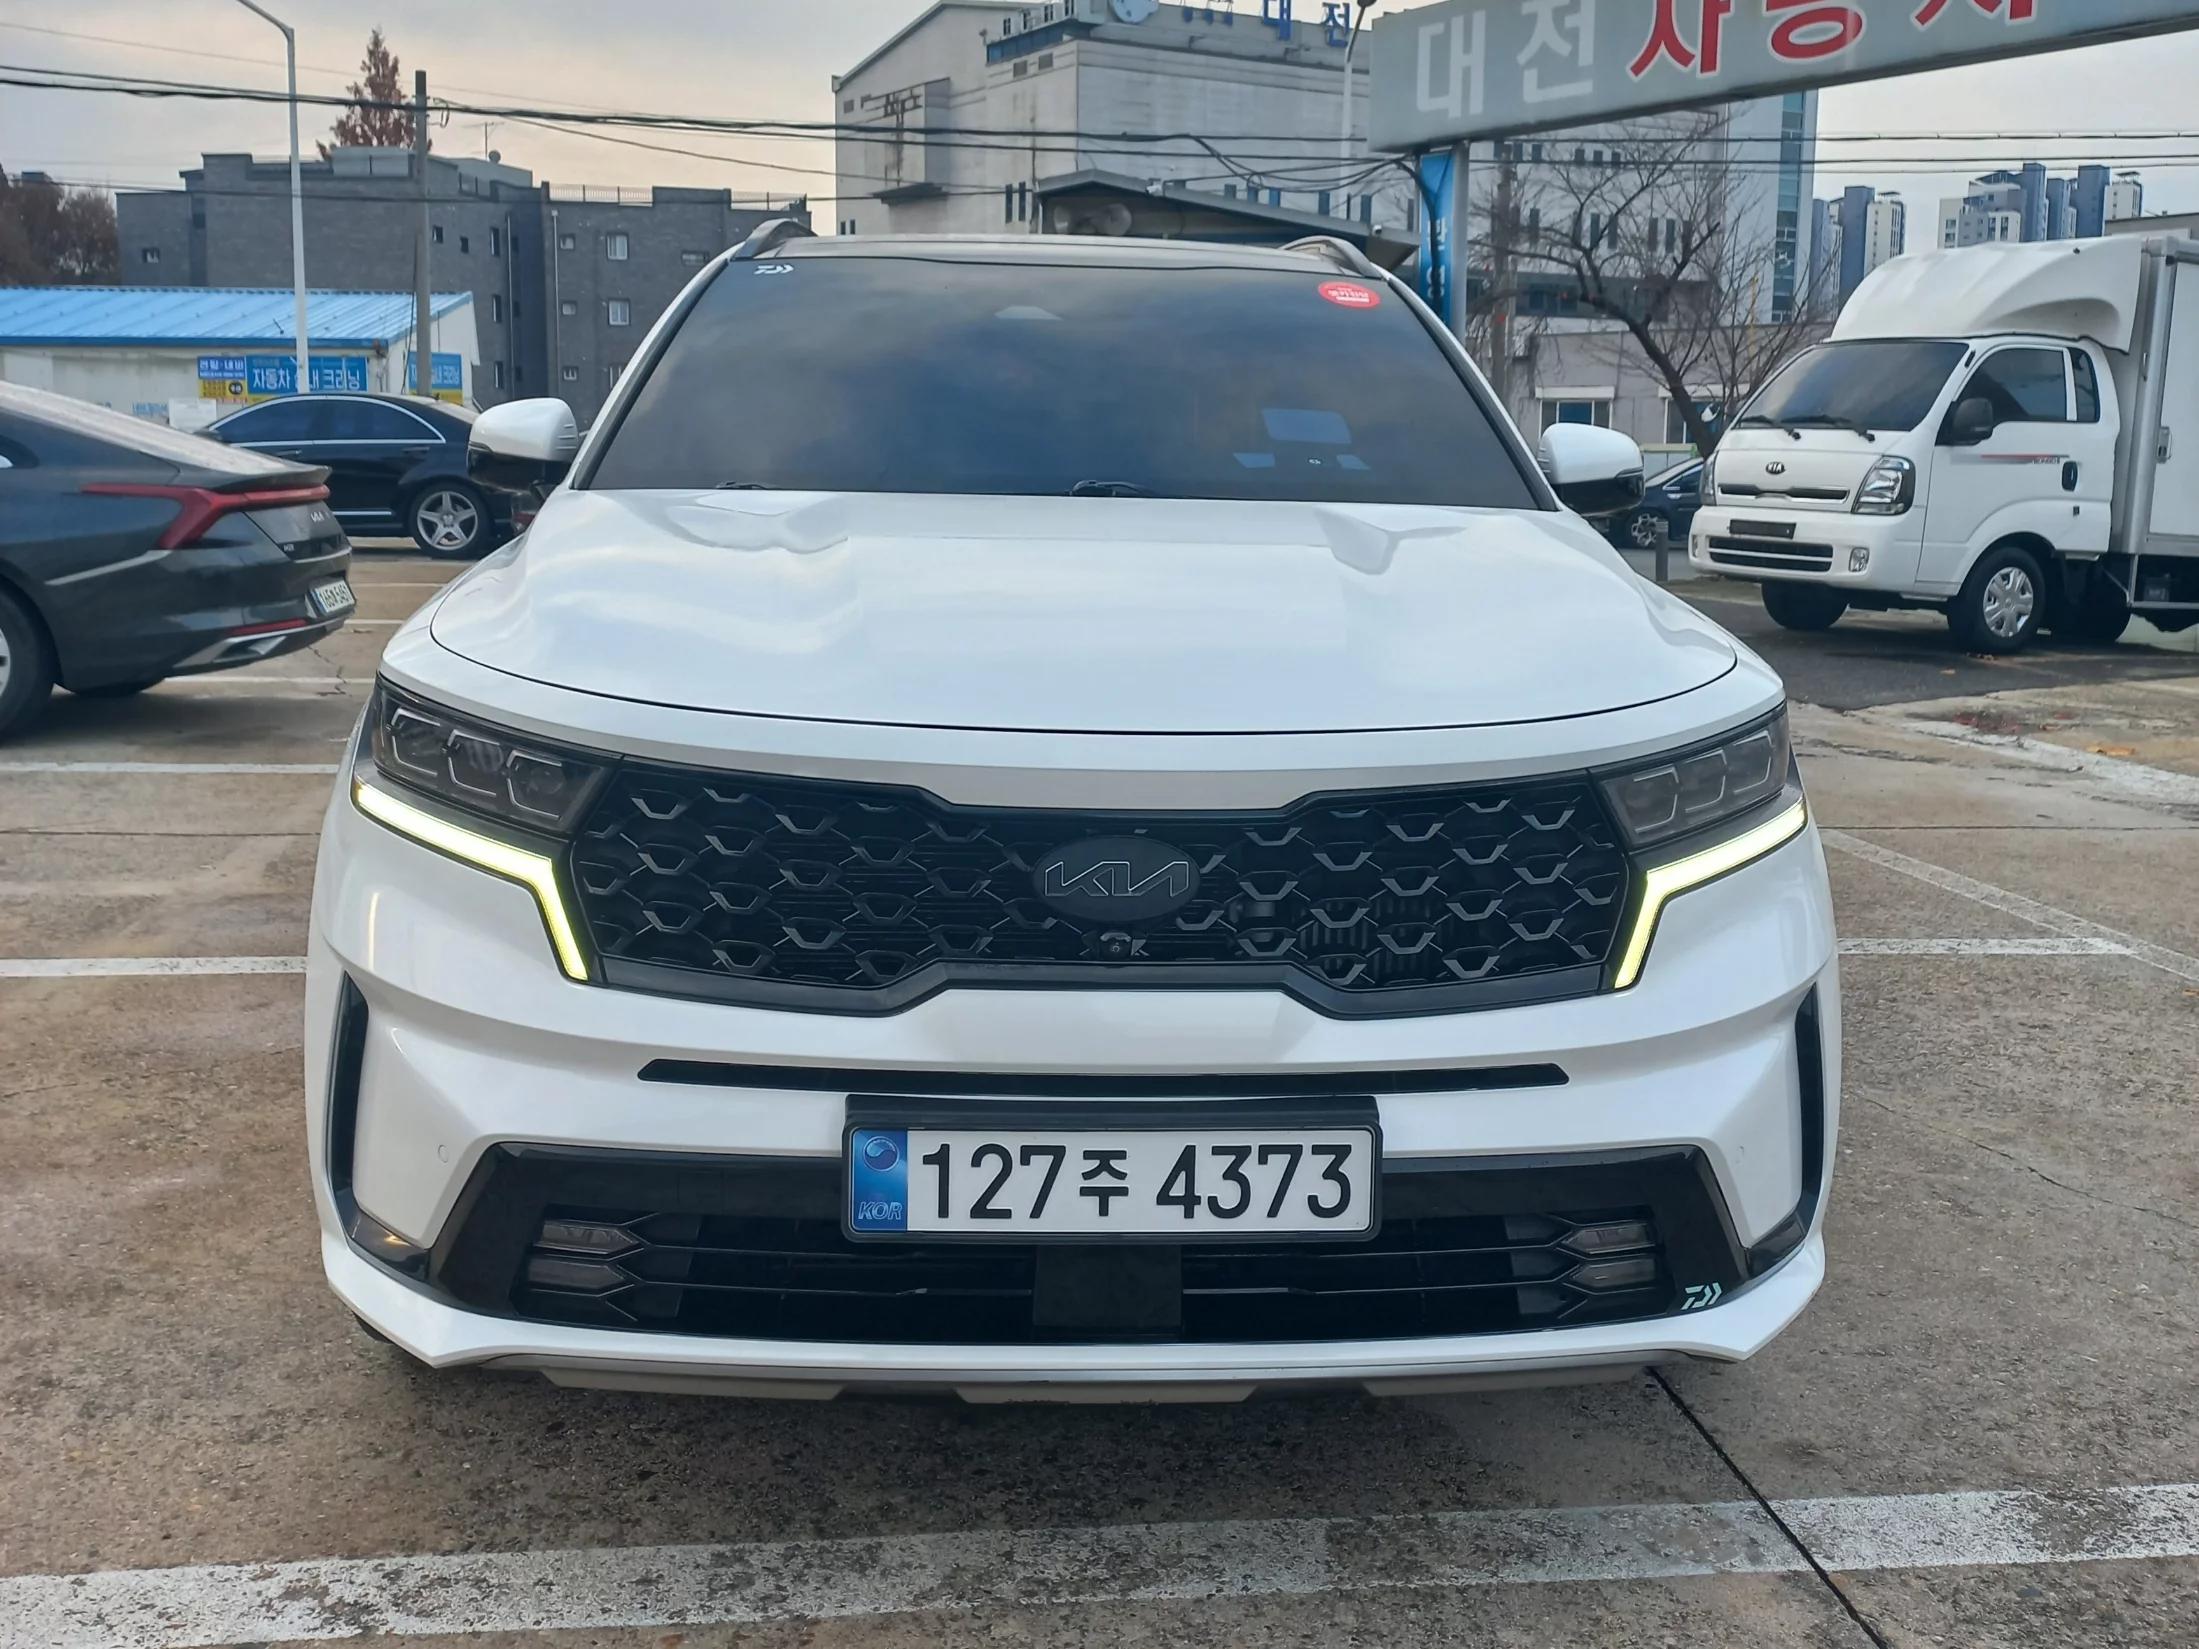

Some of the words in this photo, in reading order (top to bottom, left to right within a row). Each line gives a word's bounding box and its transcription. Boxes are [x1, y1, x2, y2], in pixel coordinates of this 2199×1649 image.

[1416, 0, 1596, 119] 대전
[253, 368, 290, 390] 자동차
[1045, 861, 1189, 897] KIA
[922, 1143, 1129, 1219] 127주
[1156, 1144, 1352, 1219] 4373
[858, 1201, 903, 1220] KOR
